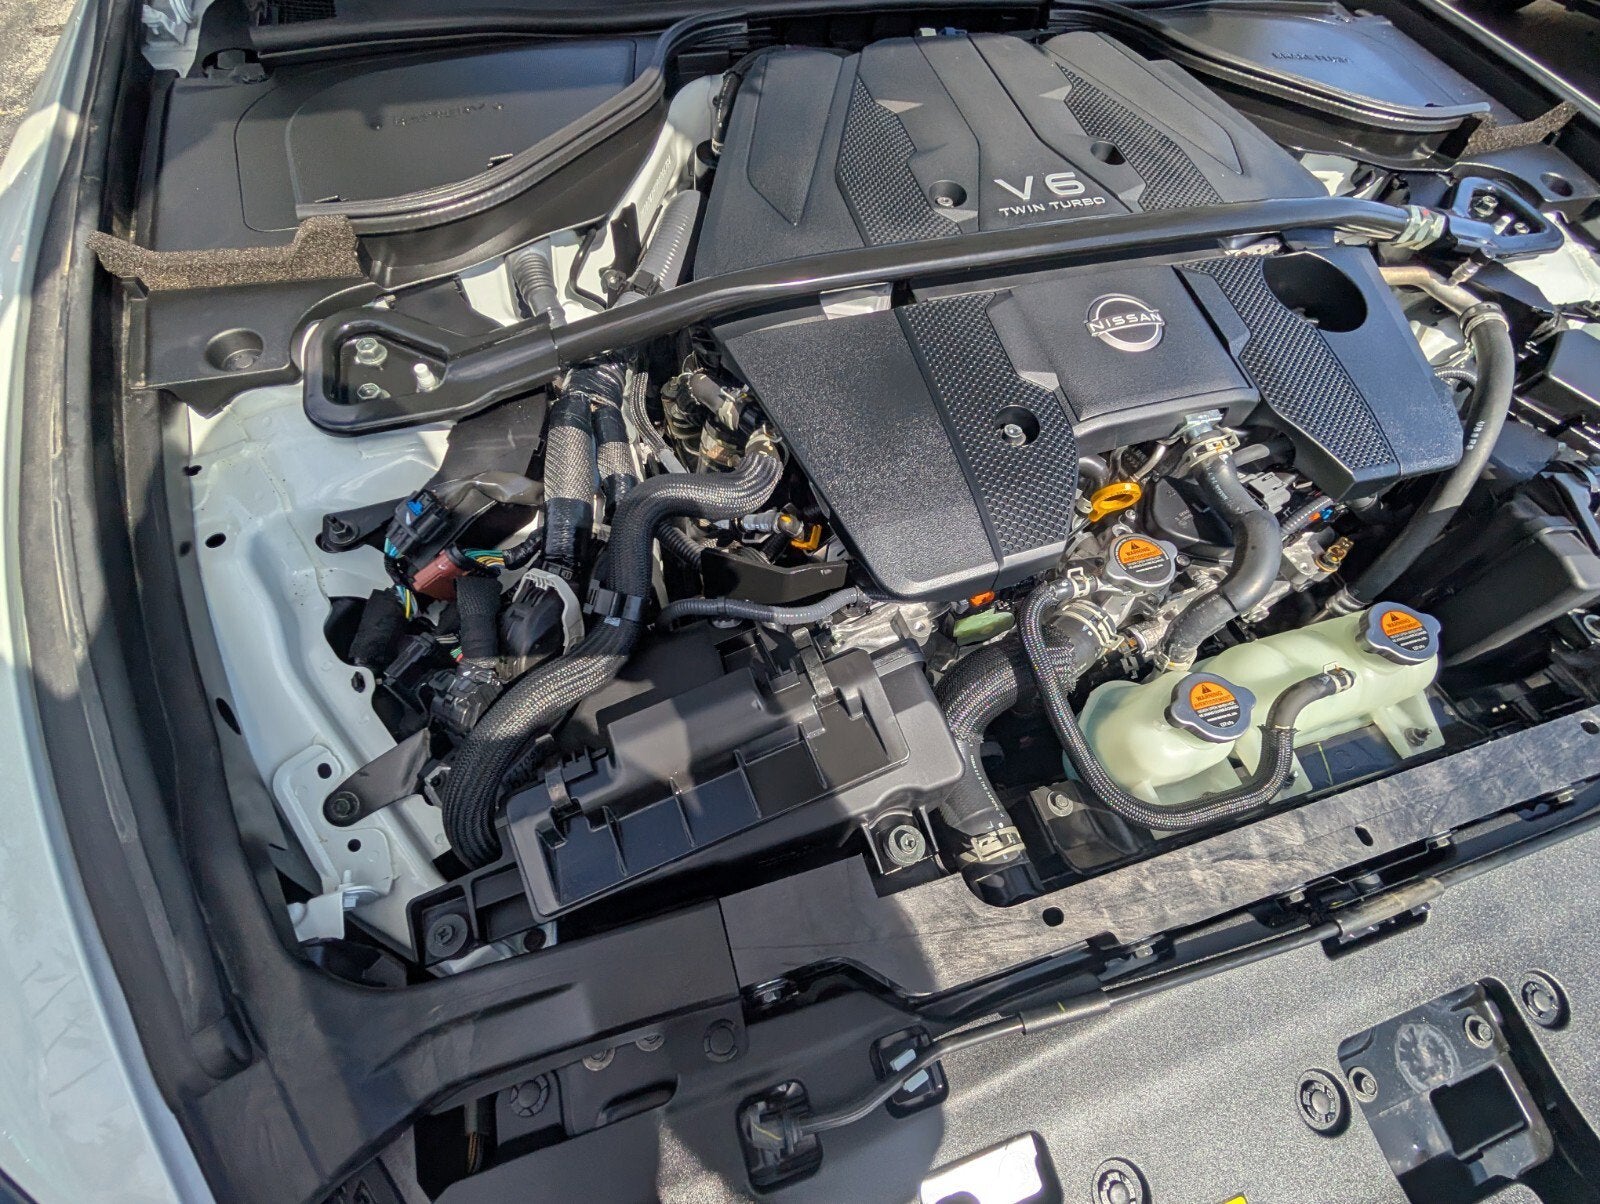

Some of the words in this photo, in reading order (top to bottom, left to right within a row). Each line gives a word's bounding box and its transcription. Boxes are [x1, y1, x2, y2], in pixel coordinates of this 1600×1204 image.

[993, 171, 1086, 201] V6
[998, 203, 1046, 217] TWIN
[1048, 196, 1106, 210] TURBO
[1089, 312, 1162, 332] NISSAN
[1195, 690, 1224, 701] WARNING
